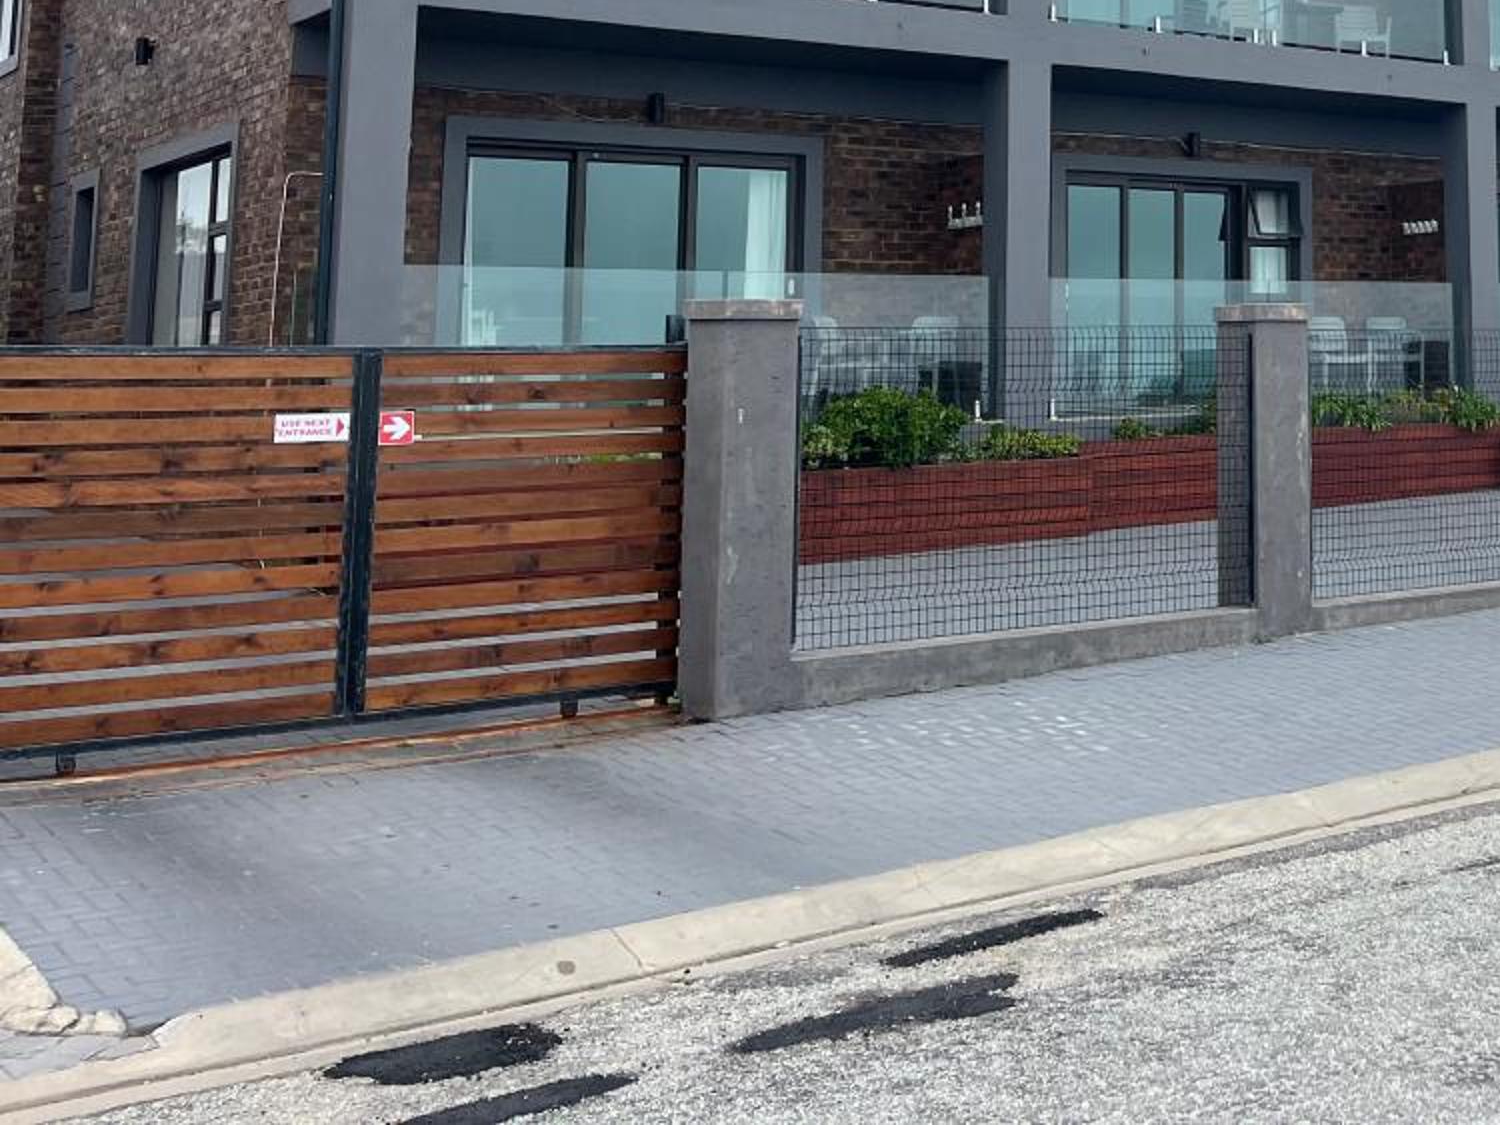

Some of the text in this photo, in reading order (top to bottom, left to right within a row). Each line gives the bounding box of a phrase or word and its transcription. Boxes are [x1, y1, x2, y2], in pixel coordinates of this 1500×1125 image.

[281, 418, 330, 428] USE NEXT
[278, 427, 332, 437] ENTRANCE
